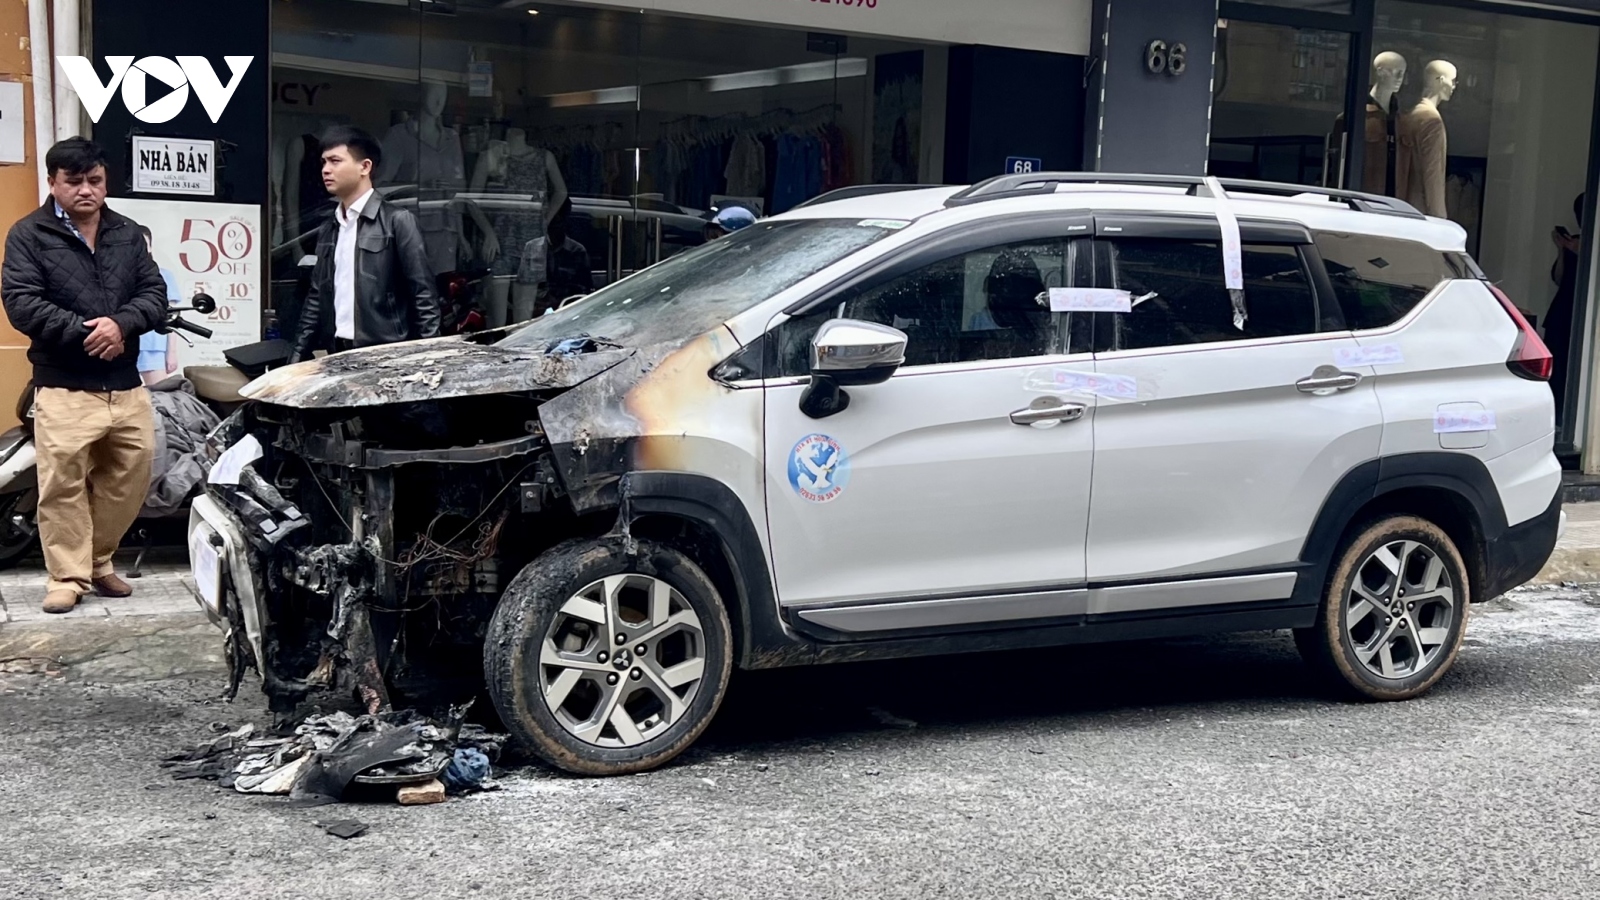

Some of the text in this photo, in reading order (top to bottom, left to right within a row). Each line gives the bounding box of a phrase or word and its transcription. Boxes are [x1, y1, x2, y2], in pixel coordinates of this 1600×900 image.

[1147, 39, 1187, 76] 66
[140, 144, 208, 173] NHÀ BÁN
[1013, 160, 1032, 173] 68
[217, 262, 252, 275] OFF
